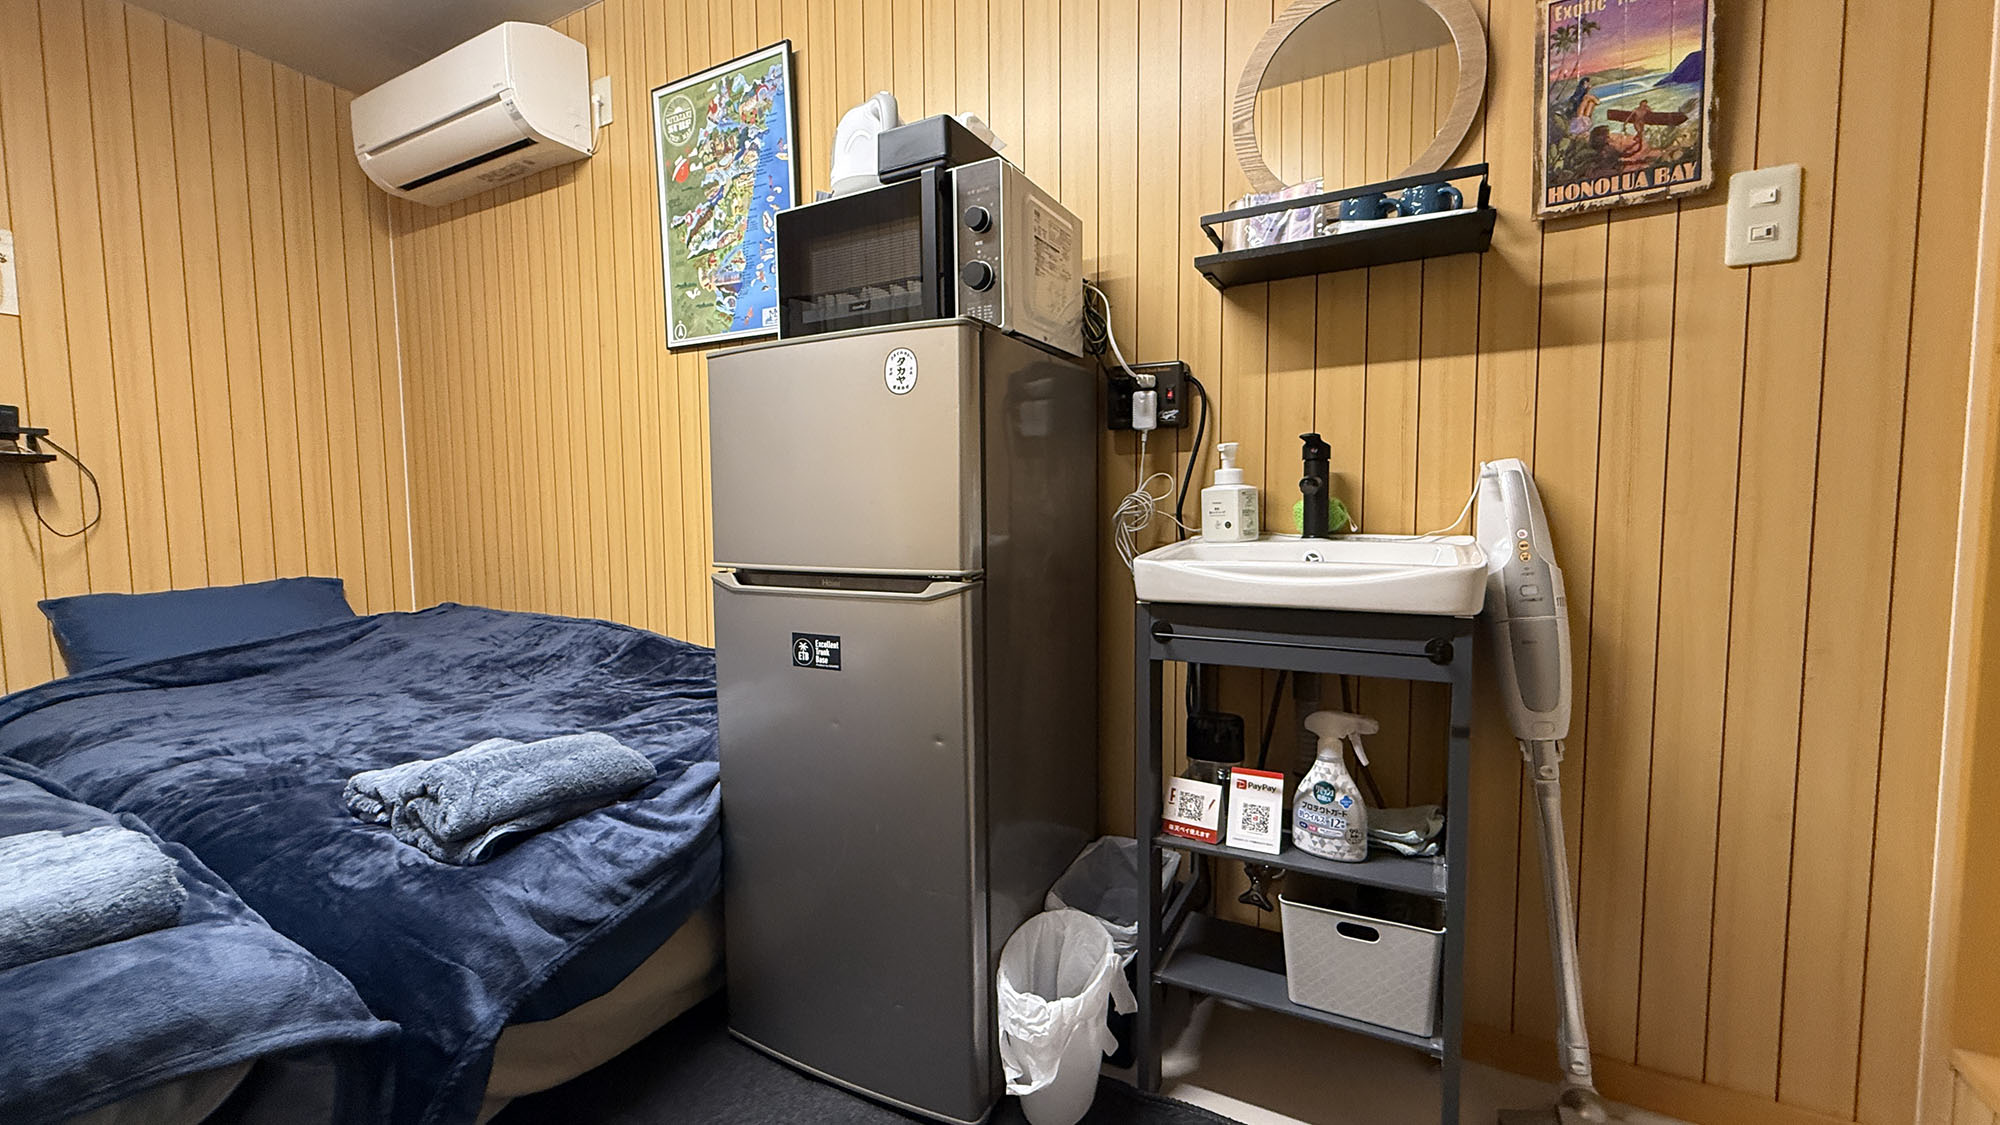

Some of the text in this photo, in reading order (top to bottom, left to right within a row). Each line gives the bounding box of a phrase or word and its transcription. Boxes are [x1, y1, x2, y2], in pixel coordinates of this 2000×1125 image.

[1554, 0, 1606, 22] Exotic
[1548, 161, 1698, 204] HONOLUA BAY
[815, 639, 839, 649] Excellent
[1247, 781, 1277, 793] PayPay
